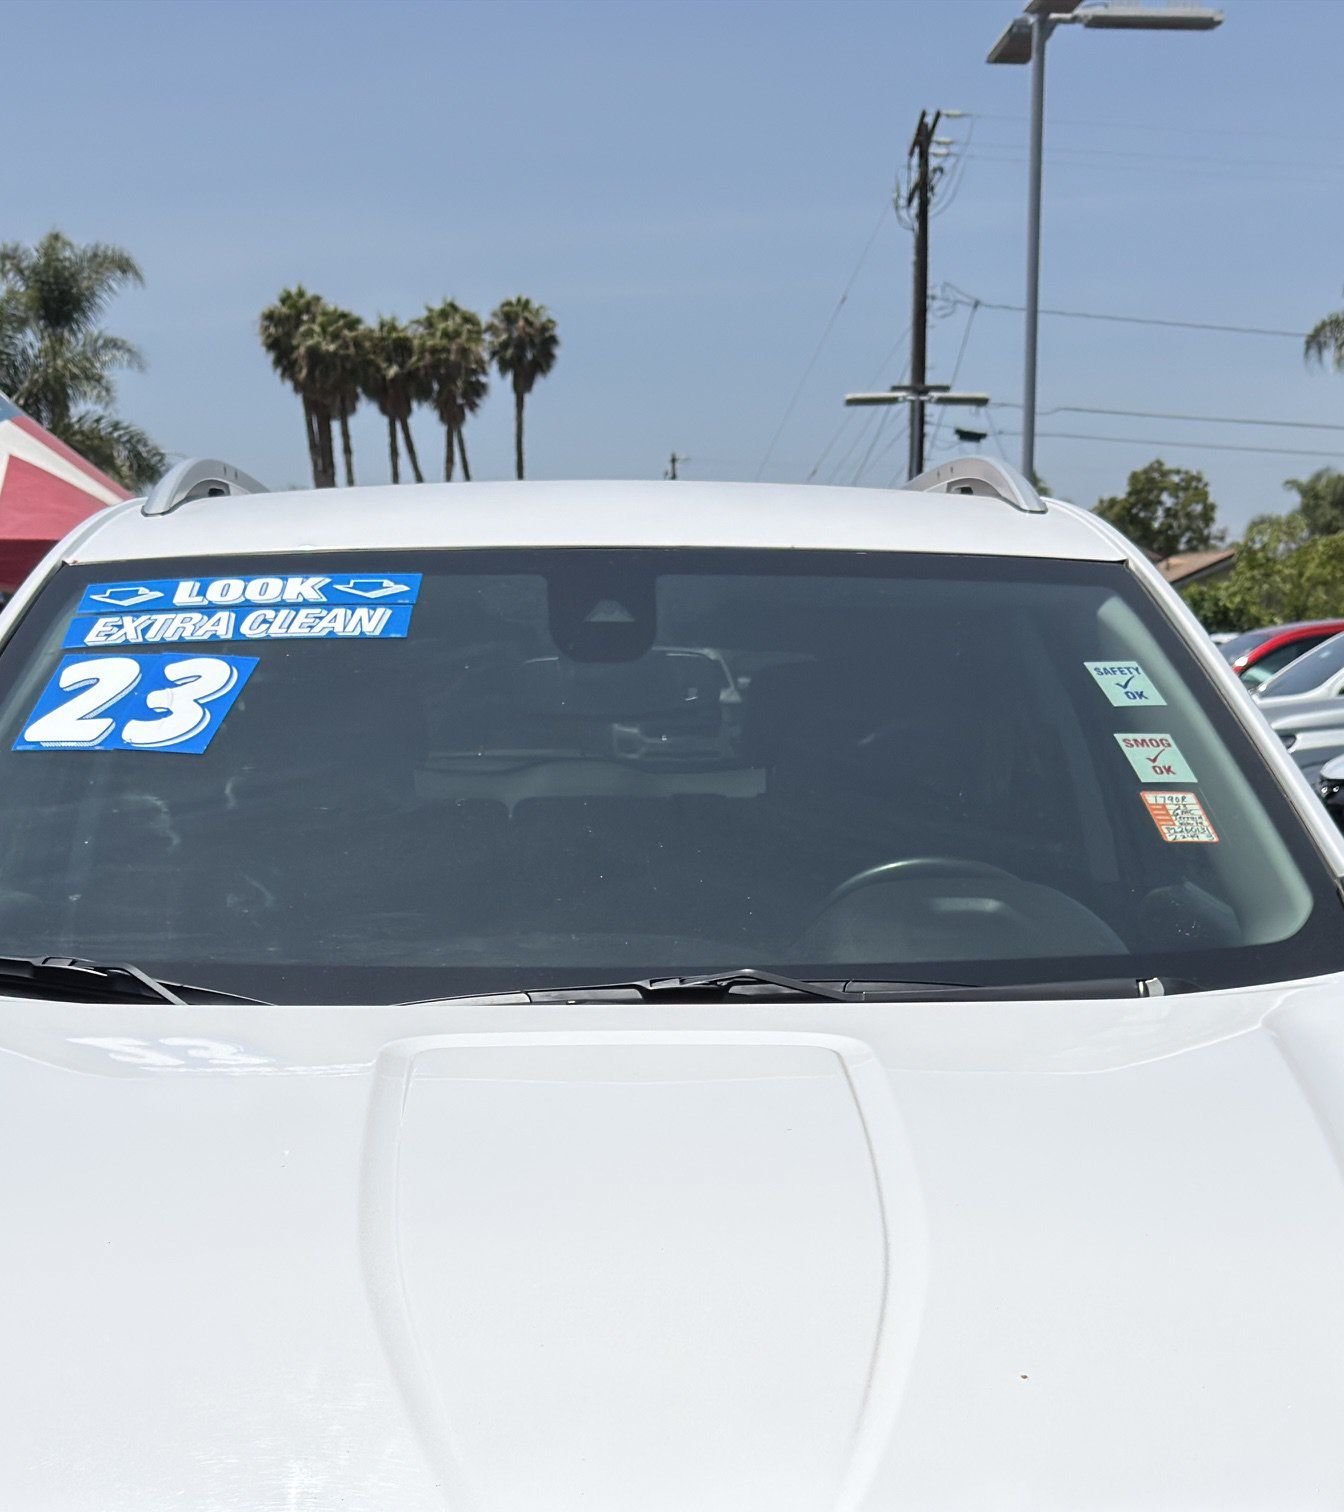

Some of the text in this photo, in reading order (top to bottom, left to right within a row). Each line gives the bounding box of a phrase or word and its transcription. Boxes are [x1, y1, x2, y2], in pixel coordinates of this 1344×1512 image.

[172, 577, 333, 606] LOOK
[84, 606, 392, 647] EXTRA CLEAN
[1094, 666, 1142, 676] SAFETY
[1124, 690, 1149, 701] OK
[23, 656, 239, 748] 23
[1122, 738, 1172, 748] SMOG
[1151, 765, 1176, 775] OK
